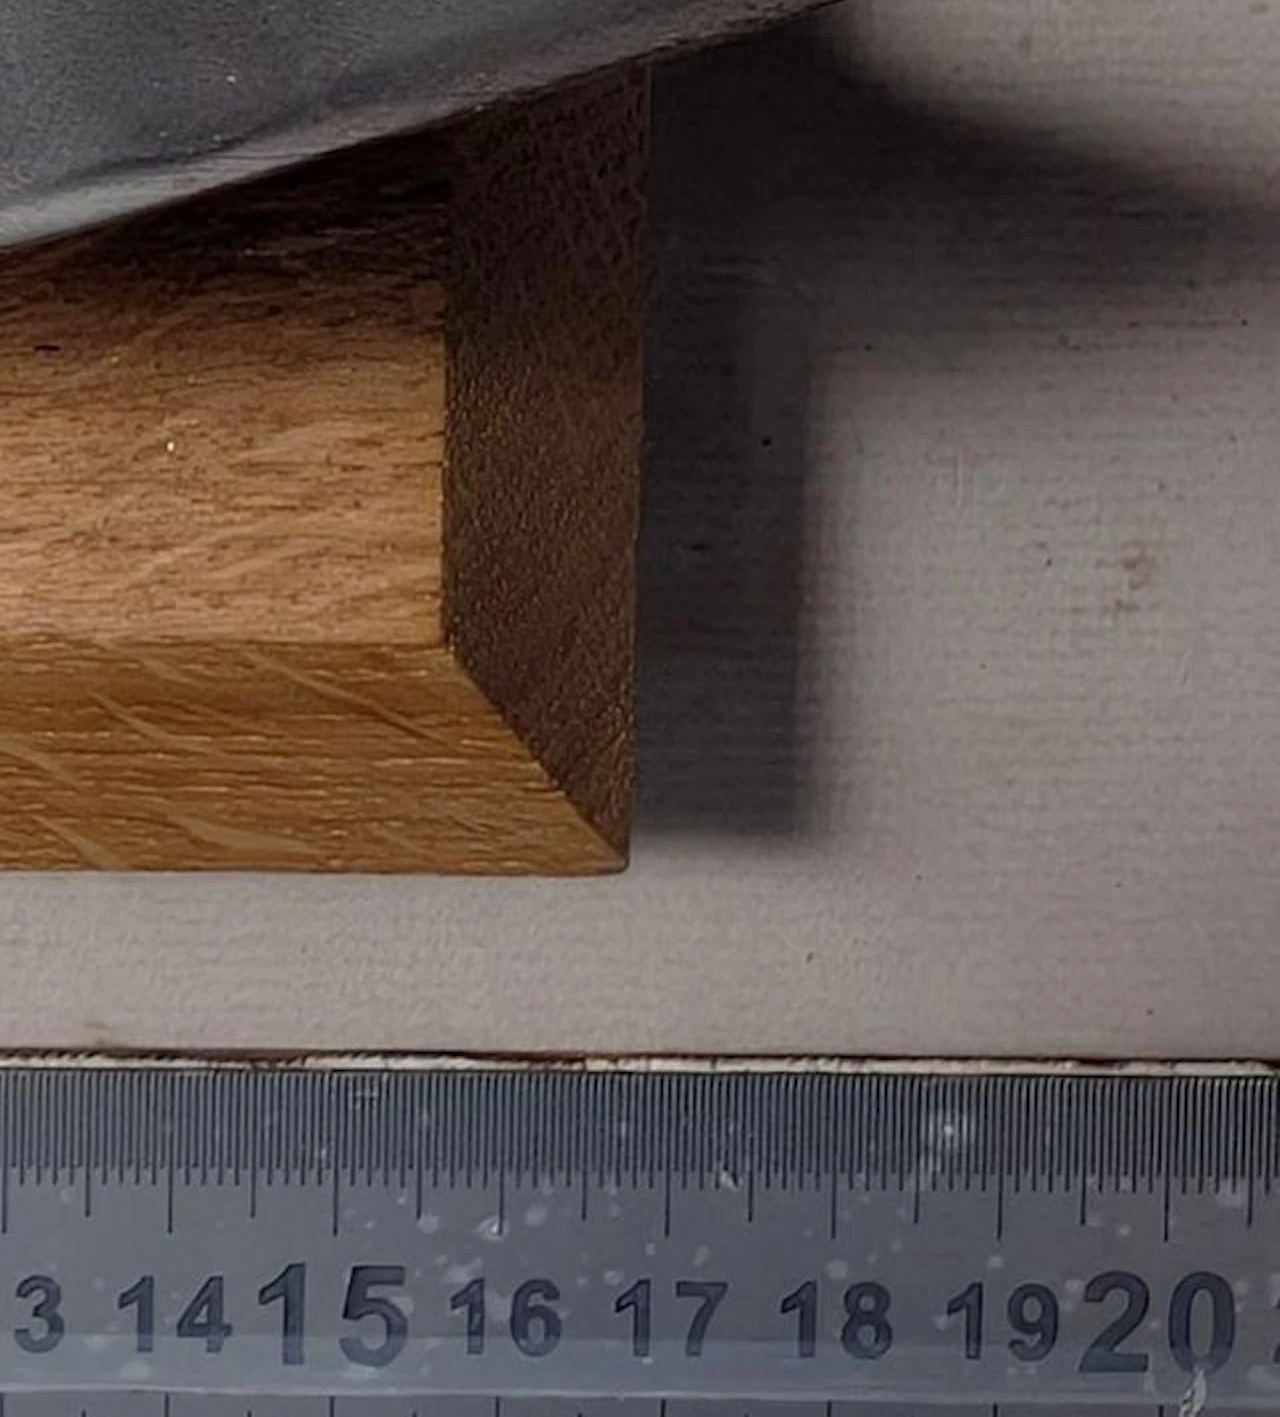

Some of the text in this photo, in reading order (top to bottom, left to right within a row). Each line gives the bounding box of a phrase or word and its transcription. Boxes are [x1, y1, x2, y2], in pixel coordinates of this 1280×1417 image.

[117, 1275, 232, 1355] 14
[258, 1262, 409, 1368] 15
[450, 1278, 562, 1357] 16
[614, 1280, 728, 1358] 17
[780, 1281, 893, 1360] 18
[945, 1283, 1059, 1361] 19
[1079, 1270, 1235, 1374] 20
